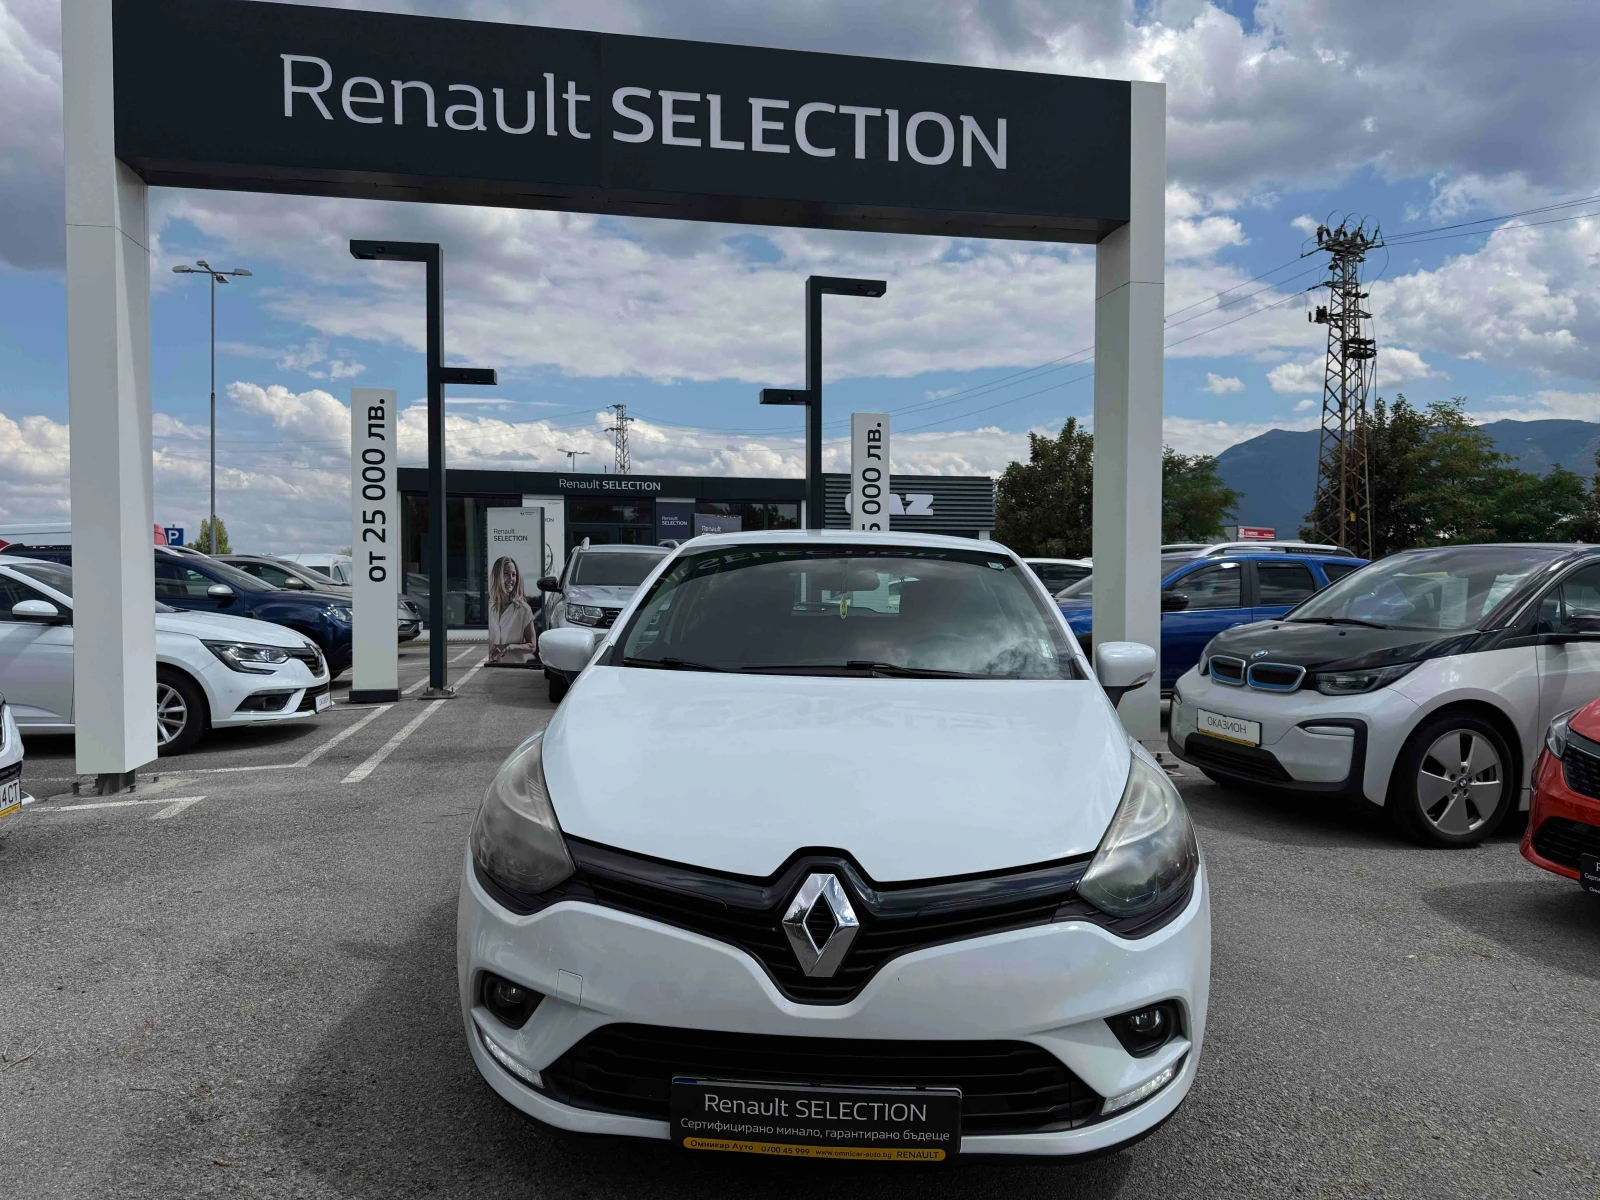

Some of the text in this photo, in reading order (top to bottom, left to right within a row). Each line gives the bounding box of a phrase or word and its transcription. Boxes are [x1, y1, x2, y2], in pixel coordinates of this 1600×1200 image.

[279, 53, 1007, 170] Renault SELECTION
[367, 398, 386, 441] лв.
[867, 422, 882, 461] лв.
[361, 448, 386, 501] 000
[558, 478, 661, 491] Renault SELECTION
[861, 467, 882, 515] 000
[168, 530, 180, 544] P
[362, 510, 386, 543] 25
[1207, 716, 1248, 735] ОКАЗИОН
[0, 782, 19, 808] 4CT
[704, 1093, 927, 1122] Renault SELECTION
[680, 1117, 950, 1142] Сертифицирано минало, гарантирано бъдеще
[690, 1139, 730, 1150] Омникар
[761, 1145, 781, 1153] 0700
[783, 1146, 793, 1154] 45
[795, 1147, 810, 1155] 999
[815, 1149, 892, 1159] www.omnicar-auto.bg
[896, 1151, 940, 1159] RENAULT
